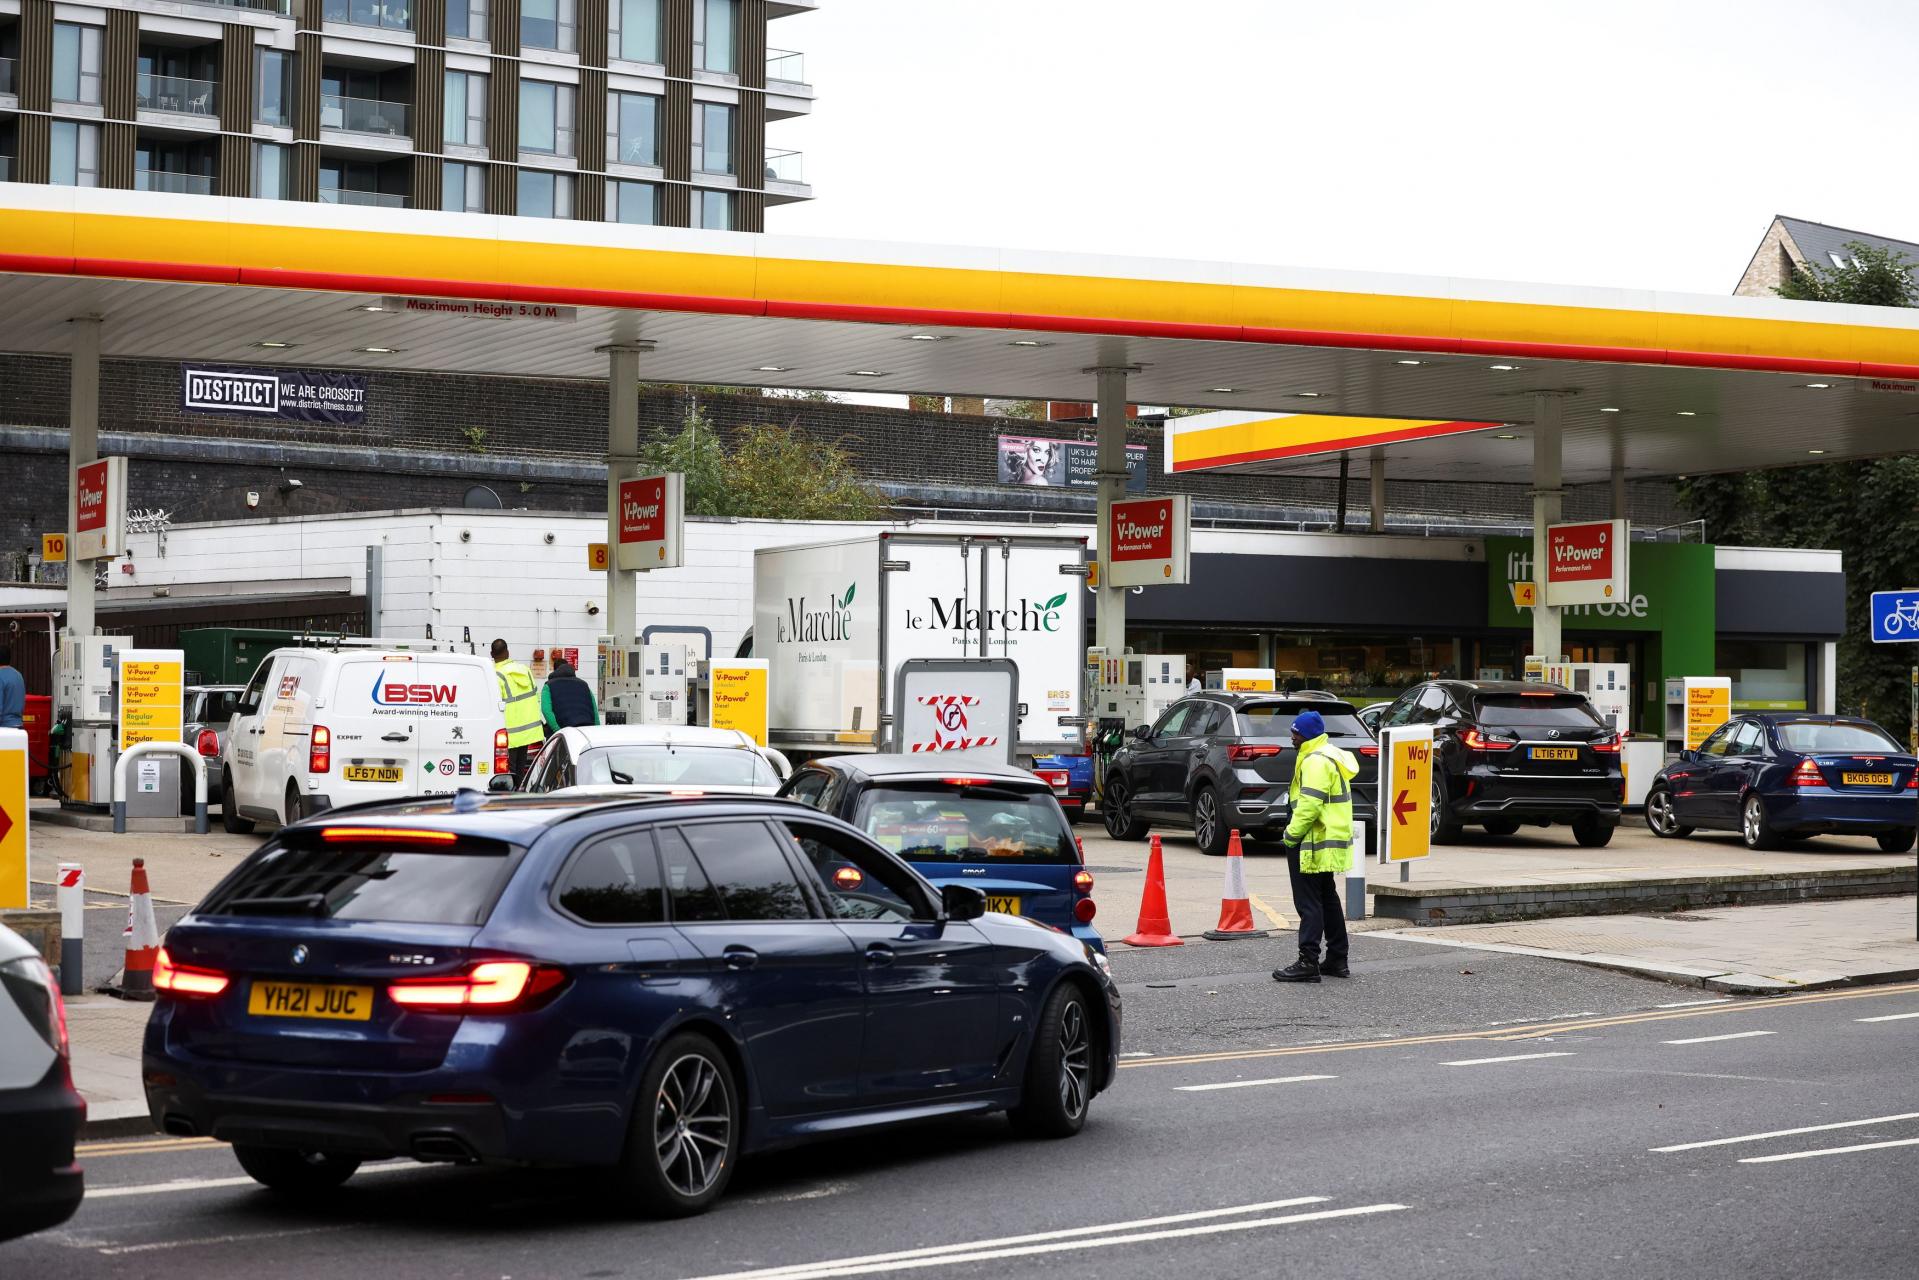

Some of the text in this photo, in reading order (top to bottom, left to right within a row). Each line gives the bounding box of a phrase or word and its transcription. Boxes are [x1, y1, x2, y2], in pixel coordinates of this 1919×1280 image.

[406, 299, 469, 313] Maximum
[474, 301, 514, 317] Height
[545, 307, 557, 317] M
[192, 378, 273, 404] DISTRICT
[1872, 381, 1916, 391] Maximum
[281, 384, 365, 402] WE ARE CROSSFIT
[280, 399, 364, 412] www.district-fitness.co.uk
[1070, 448, 1085, 456] UK'S
[1081, 458, 1096, 466] HAIR
[80, 488, 103, 509] V-Power
[623, 502, 659, 520] V-Power
[1117, 522, 1164, 540] V-Power
[47, 539, 64, 553] 10
[1117, 544, 1142, 552] Performance
[595, 549, 605, 564] 8
[1554, 545, 1604, 562] V-Power
[1555, 563, 1592, 573] Performance Fuels
[1523, 588, 1532, 600] 4
[905, 609, 922, 629] le
[777, 616, 786, 643] le
[952, 637, 971, 645] Paris
[988, 637, 1018, 645] London
[384, 683, 457, 704] BSW
[126, 713, 153, 721] Regular
[372, 708, 459, 718] Award-winning Heating
[126, 735, 153, 743] Regular
[1407, 745, 1429, 764] Way
[1535, 749, 1575, 759] LT16 RTV
[347, 768, 399, 780] LF67 NDN
[442, 764, 453, 772] 70
[1407, 766, 1416, 780] In
[1847, 773, 1870, 783] BK06
[926, 824, 939, 834] 60
[264, 986, 358, 1014] YH21 JUC
